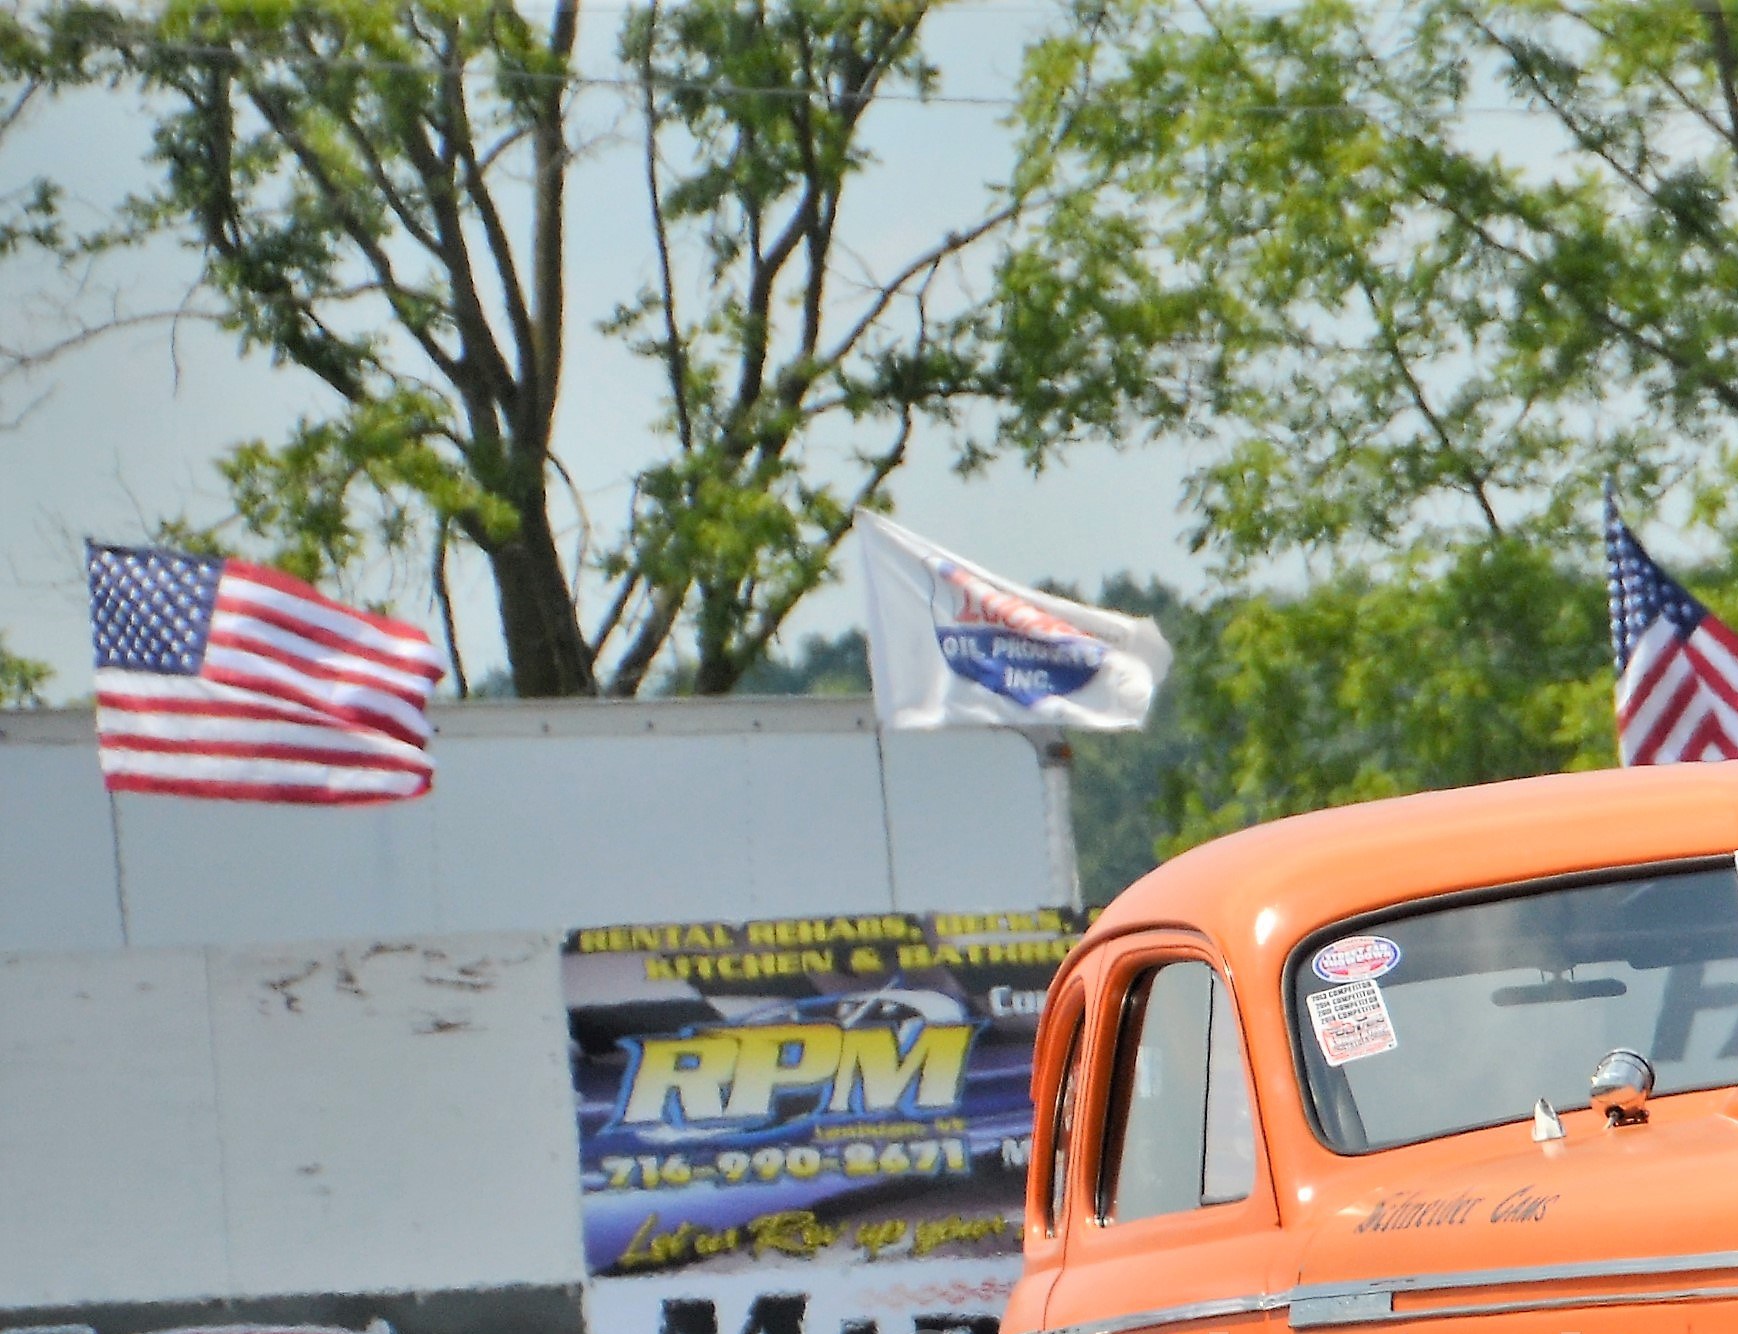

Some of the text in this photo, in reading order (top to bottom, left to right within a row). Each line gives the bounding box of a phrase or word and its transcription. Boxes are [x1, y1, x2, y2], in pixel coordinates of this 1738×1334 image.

[579, 922, 734, 953] RENTAL
[643, 950, 834, 981] KITCHEN
[850, 945, 883, 974] &
[1328, 981, 1372, 998] COMPETITOR
[1332, 988, 1376, 1005] COMPETITOR
[1334, 996, 1378, 1012] COMPETITOR
[1337, 1003, 1381, 1020] COMPETITOR
[623, 1024, 974, 1124] RPM
